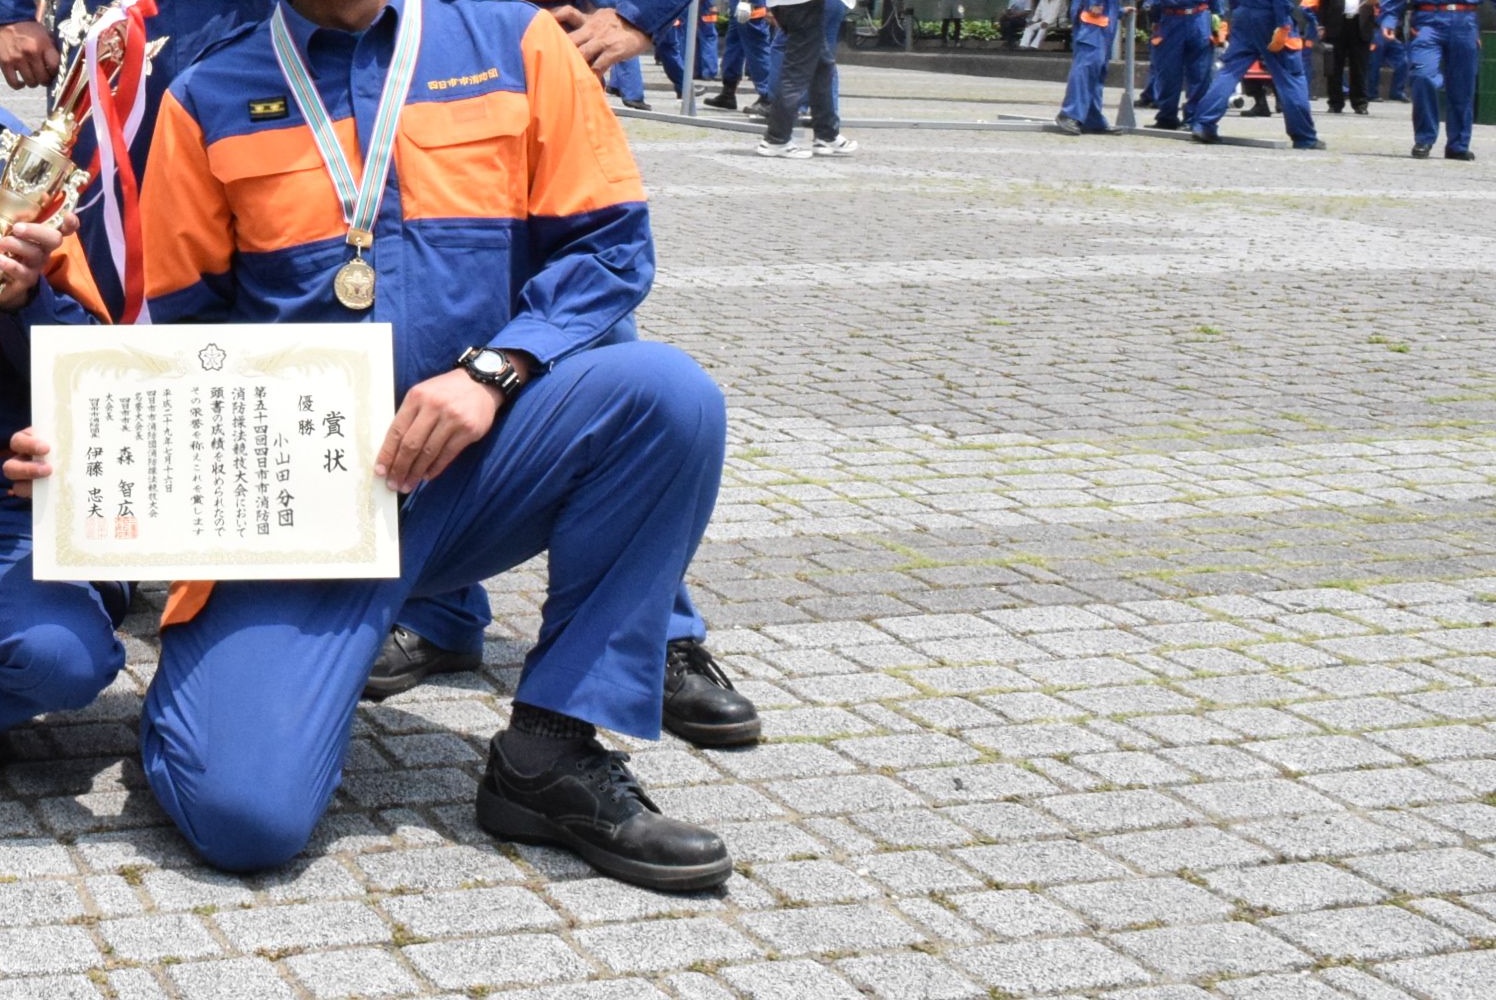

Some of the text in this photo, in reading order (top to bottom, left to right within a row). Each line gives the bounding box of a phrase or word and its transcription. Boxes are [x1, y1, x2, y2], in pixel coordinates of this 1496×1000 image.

[298, 394, 315, 436] 優勝
[322, 410, 348, 473] 賞状
[273, 432, 295, 527] 小山田分団
